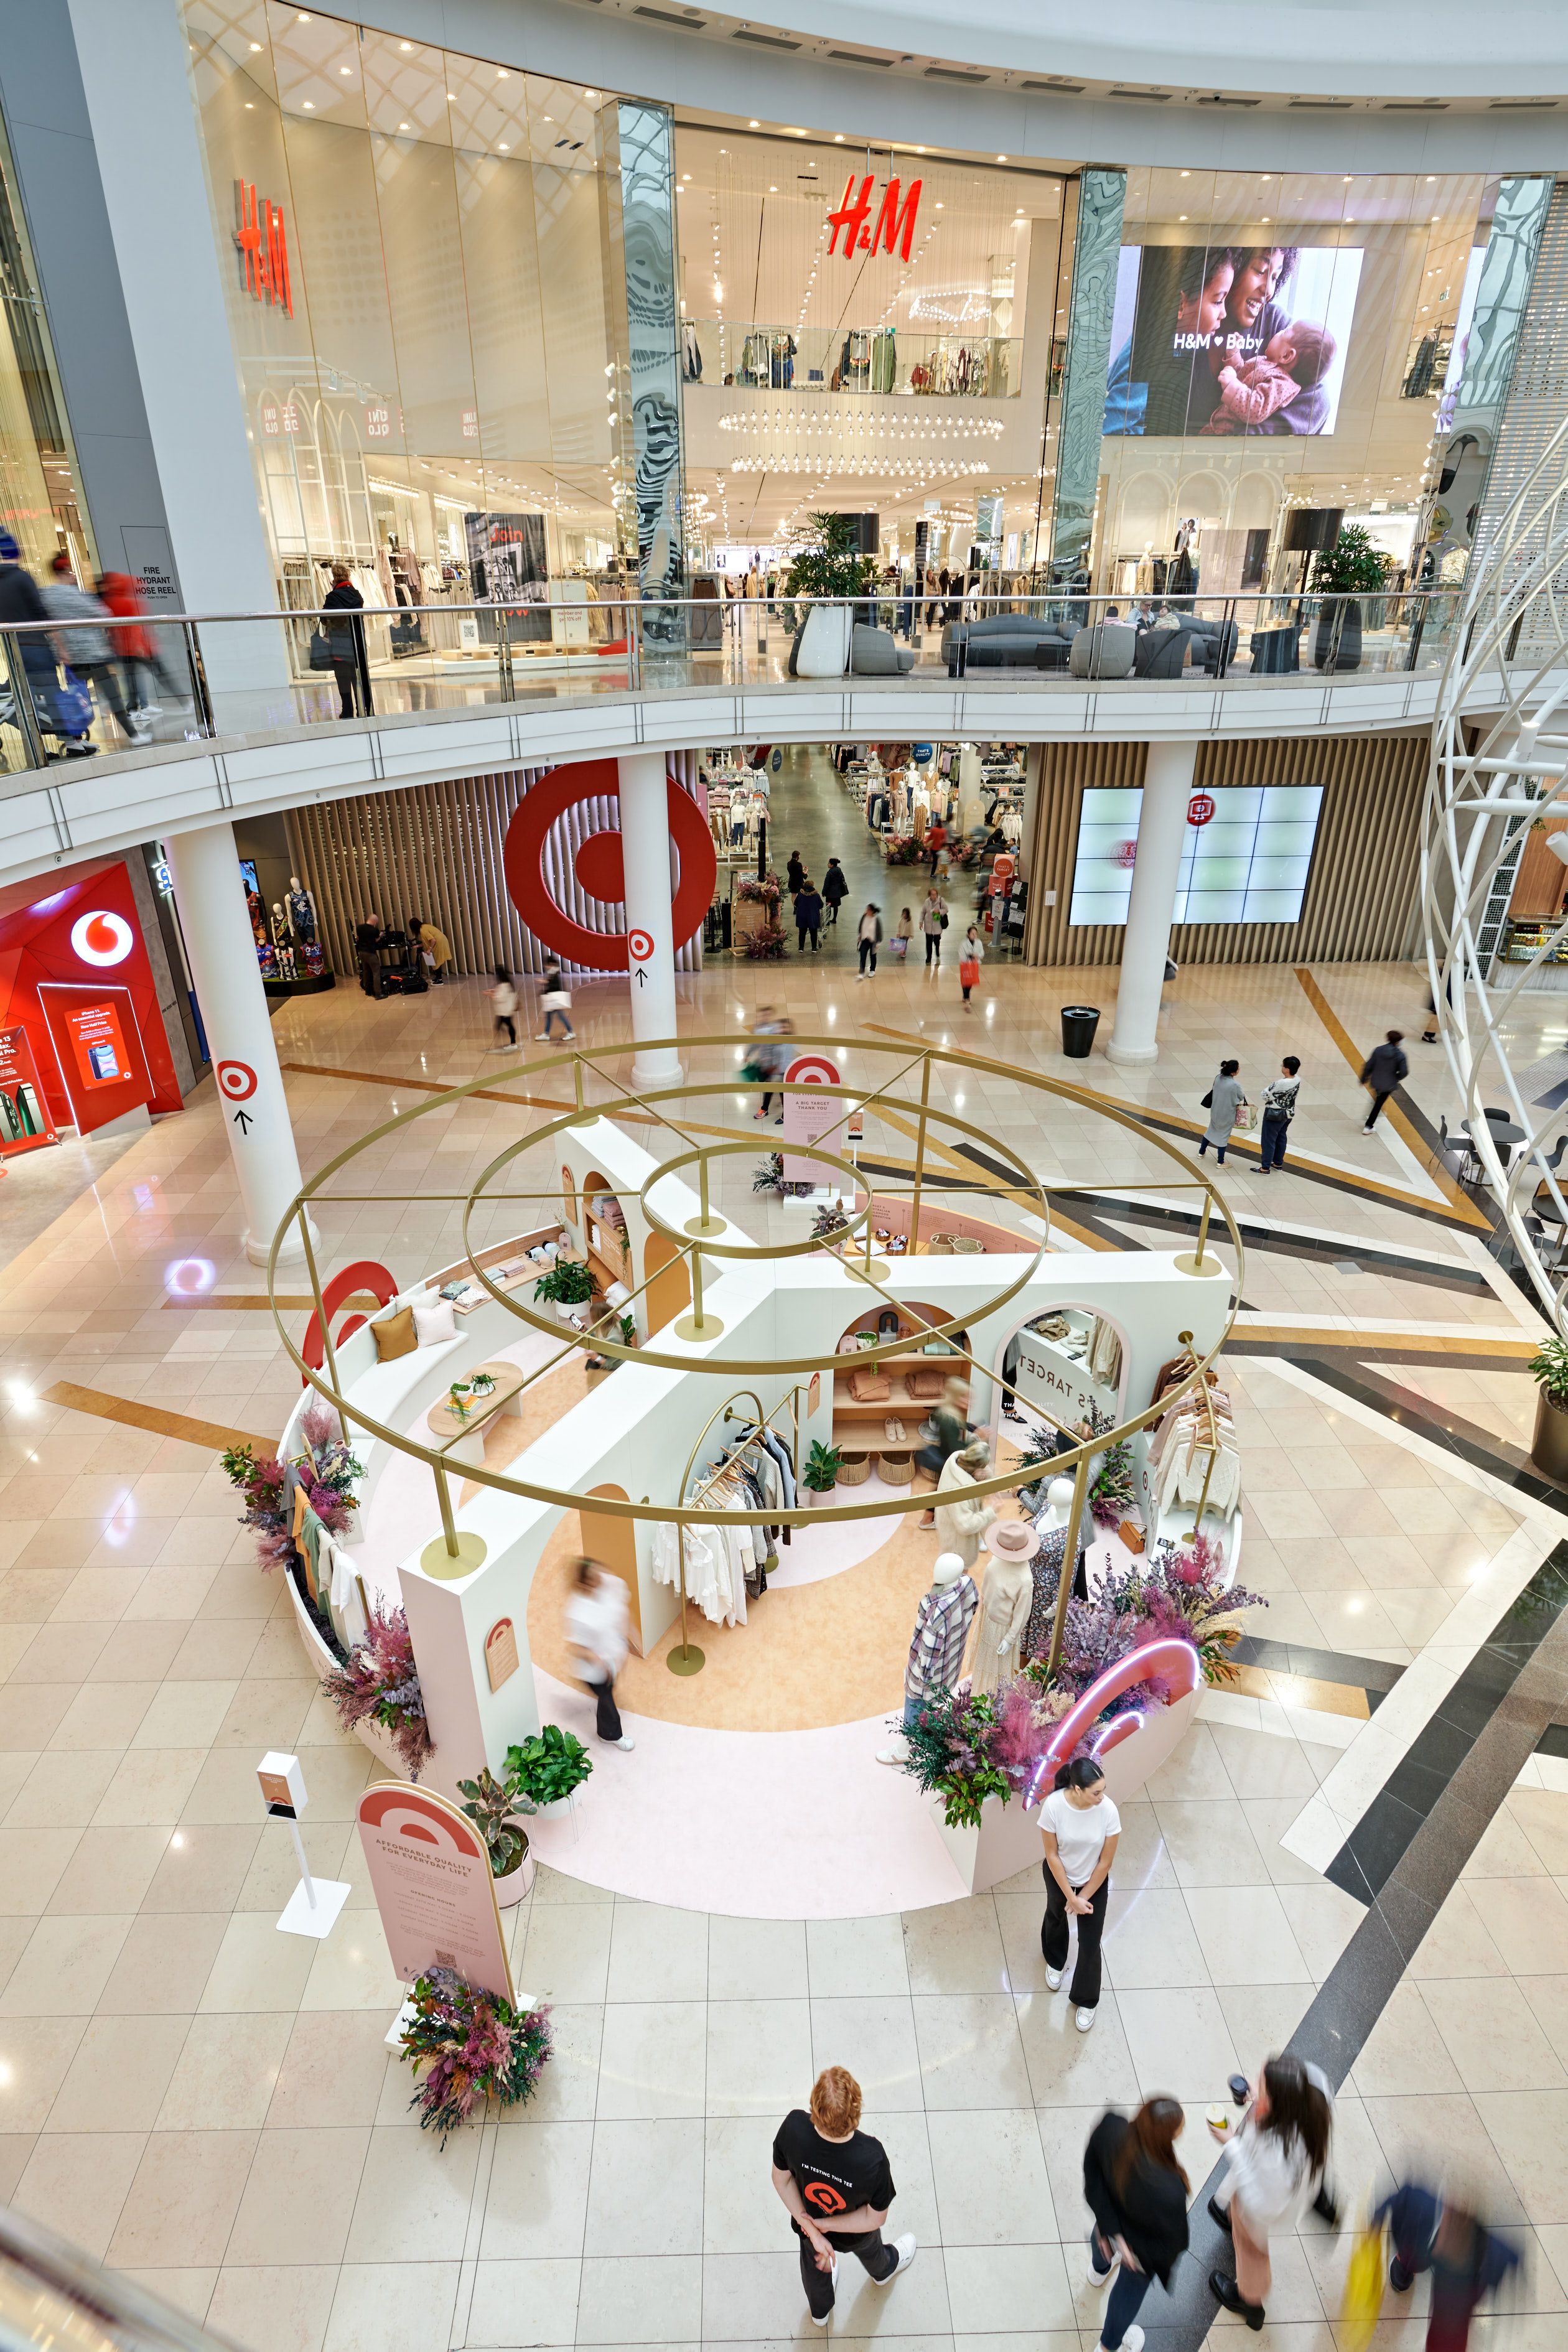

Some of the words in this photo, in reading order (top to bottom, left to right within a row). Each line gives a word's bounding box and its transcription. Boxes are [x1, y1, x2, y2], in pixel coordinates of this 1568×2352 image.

[827, 174, 922, 263] H&M
[236, 177, 294, 320] H&M
[1174, 333, 1211, 350] H&M
[1226, 334, 1264, 353] Baby
[489, 525, 524, 543] Join
[135, 587, 157, 595] HOSE
[157, 586, 177, 594] REEL
[136, 576, 170, 584] HYDRANT
[376, 1839, 431, 1860] AFFORDABLE
[434, 1857, 472, 1872] QUALITY
[382, 1846, 399, 1855] FOR
[403, 1853, 446, 1870] EVERYDAY
[449, 1867, 469, 1877] LIFE
[410, 1890, 436, 1900] OPENING
[437, 1898, 456, 1907] HOURS
[810, 2166, 830, 2178] TESTING
[831, 2175, 842, 2184] THIS
[843, 2180, 853, 2188] TEE
